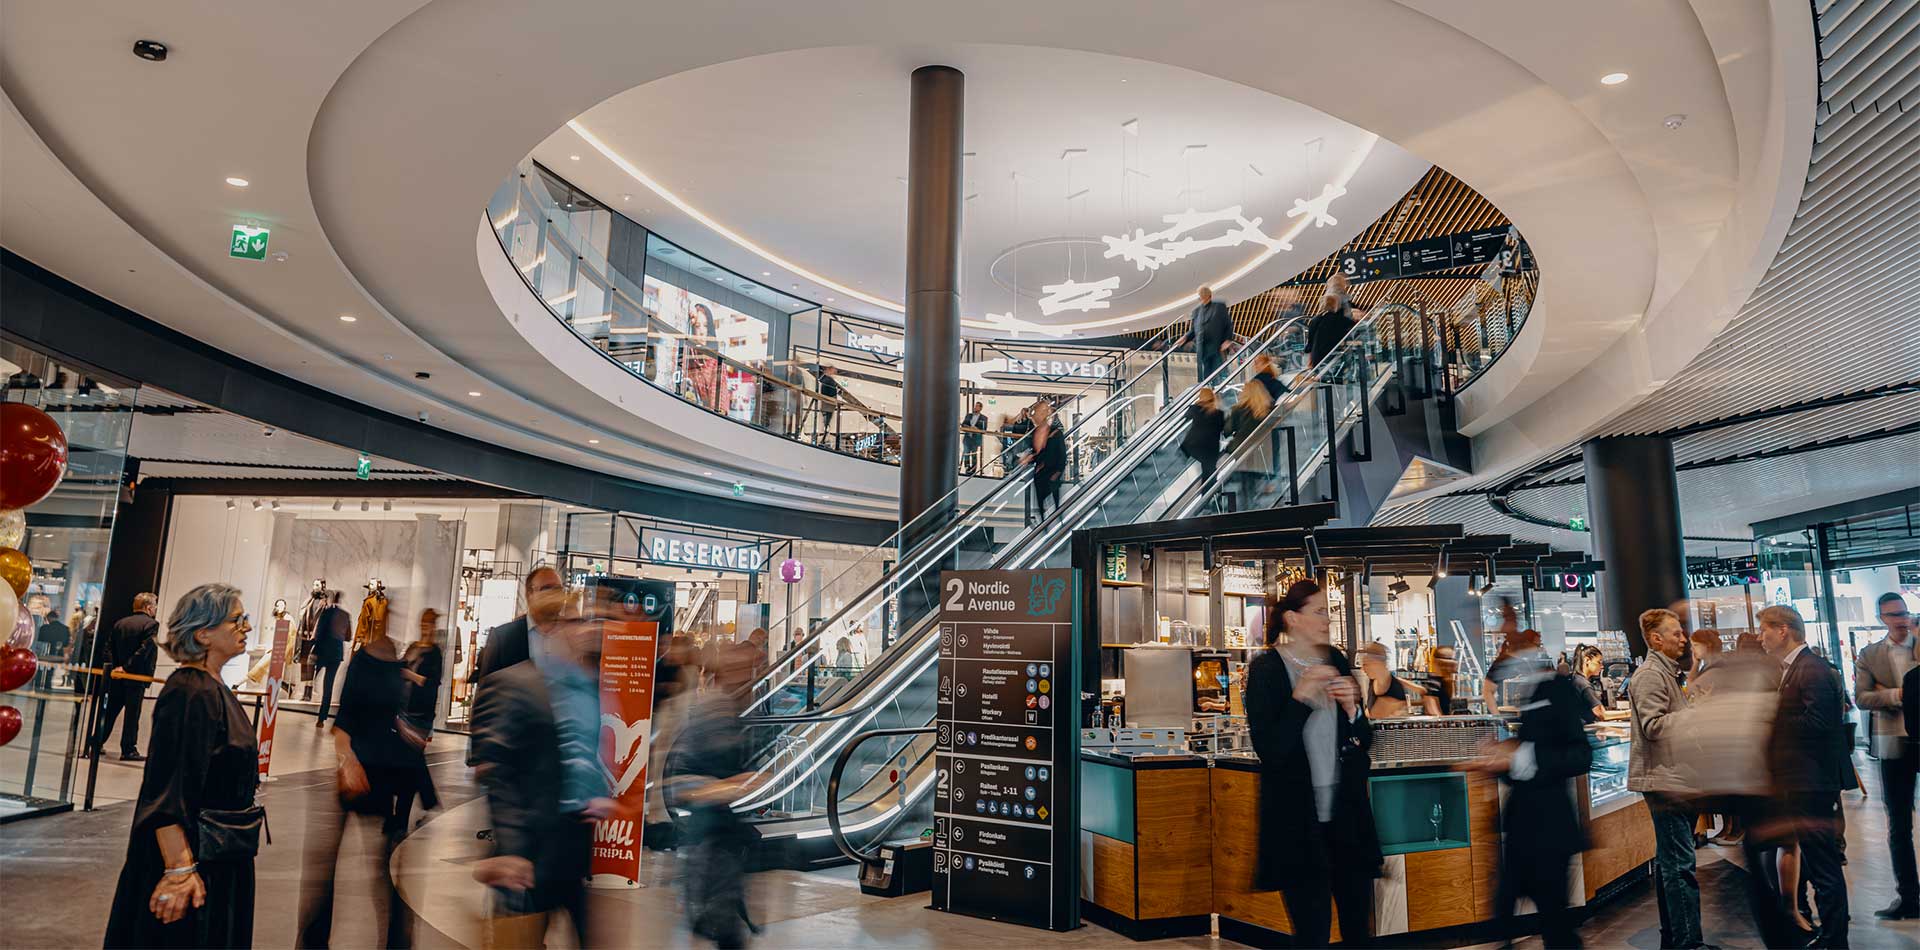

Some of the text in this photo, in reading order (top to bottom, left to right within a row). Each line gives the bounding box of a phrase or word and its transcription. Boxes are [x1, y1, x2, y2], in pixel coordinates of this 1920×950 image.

[1344, 258, 1356, 275] 3
[1003, 357, 1105, 378] ESERVED
[653, 537, 761, 570] RESERVED
[945, 578, 964, 611] 2
[968, 581, 1010, 595] Nordic
[968, 598, 1016, 611] Avenue
[941, 626, 953, 646] 5
[940, 676, 951, 696] 4
[939, 724, 950, 744] 3
[937, 769, 949, 789] 2
[594, 820, 634, 846] MALL
[936, 818, 948, 838] 1
[592, 847, 634, 860] TRIPLA
[934, 851, 946, 872] P
